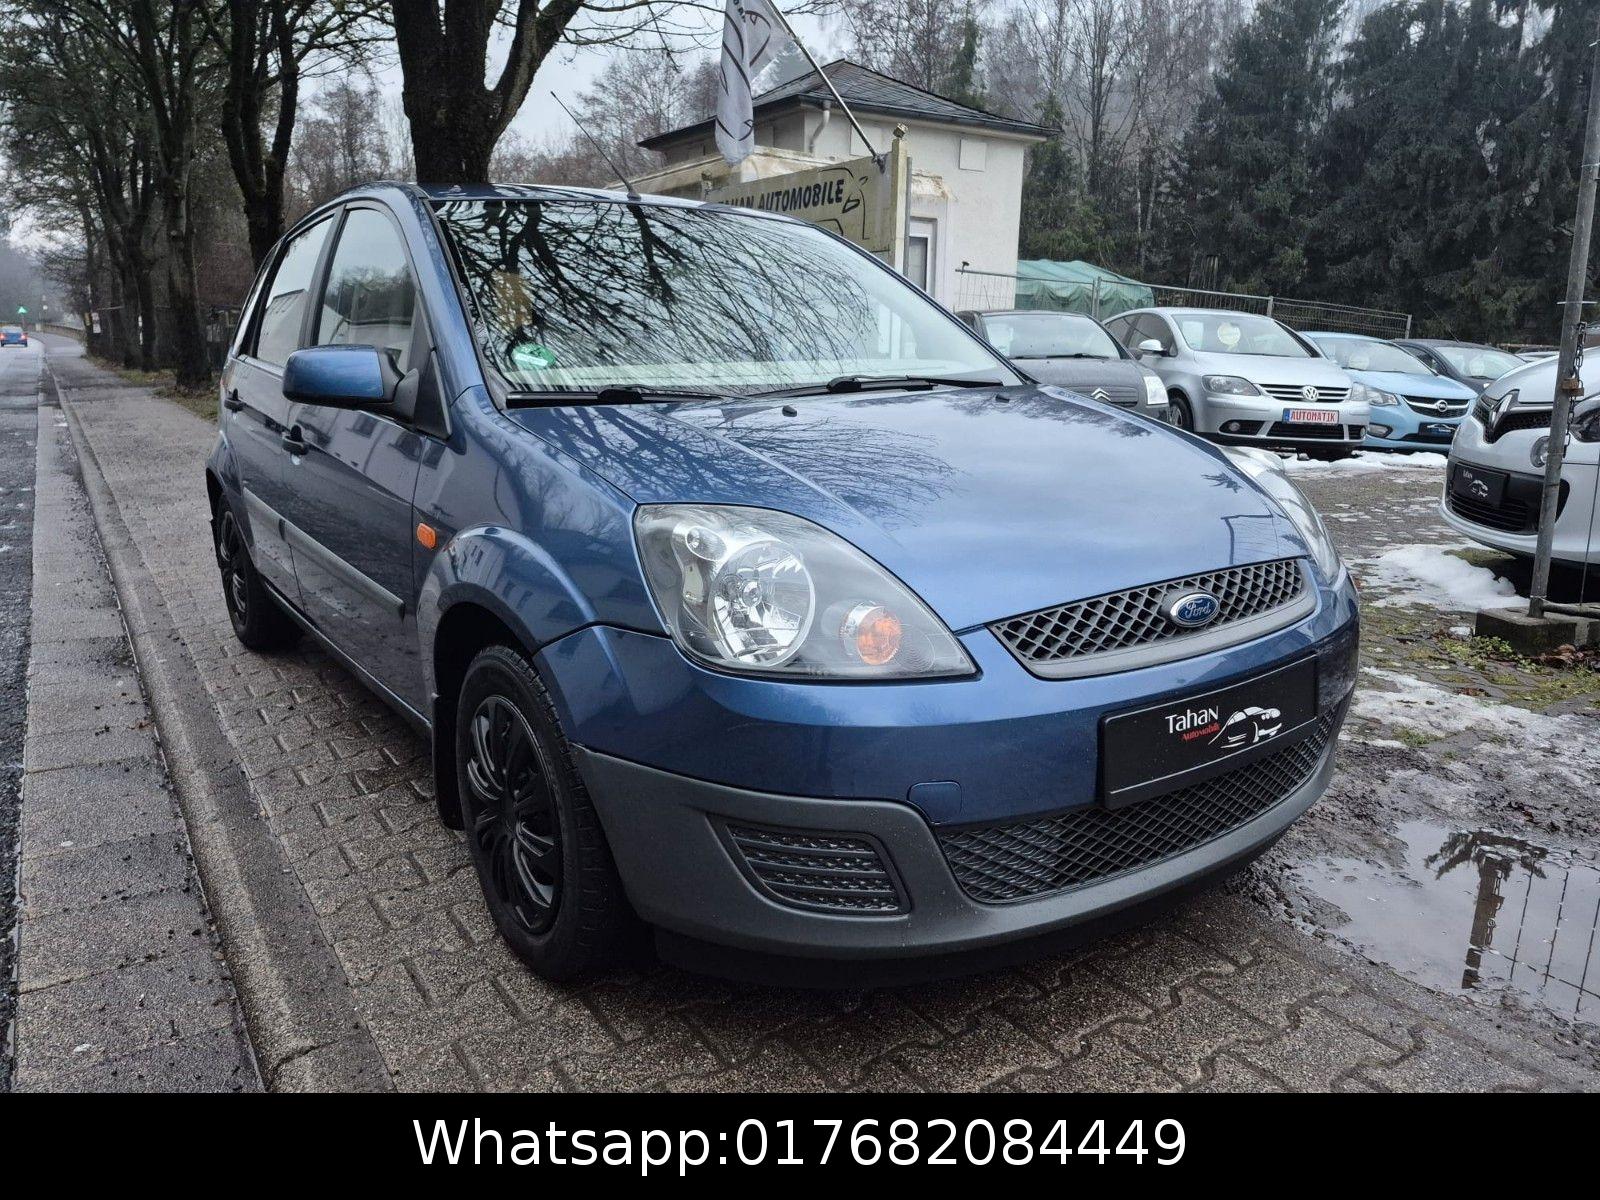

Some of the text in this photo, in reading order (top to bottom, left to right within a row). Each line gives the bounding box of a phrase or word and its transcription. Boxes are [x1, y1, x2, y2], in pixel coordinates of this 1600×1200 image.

[758, 179, 845, 212] AUTOMOBILE
[1291, 410, 1336, 422] AUTOMATIK
[1185, 599, 1211, 619] Ford
